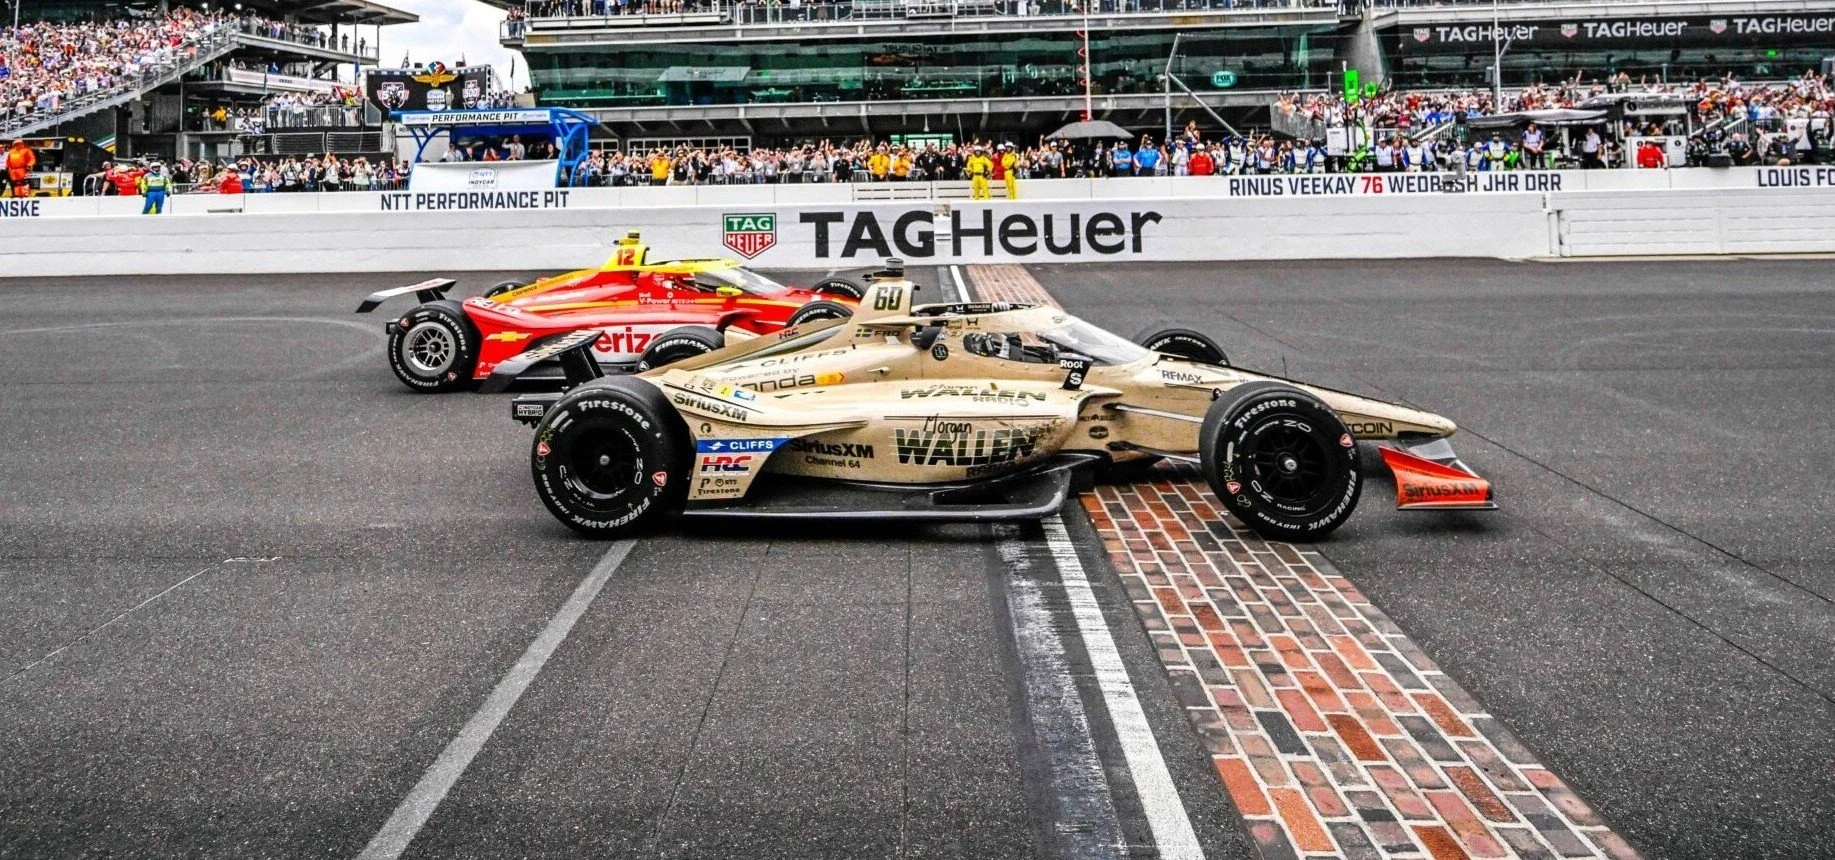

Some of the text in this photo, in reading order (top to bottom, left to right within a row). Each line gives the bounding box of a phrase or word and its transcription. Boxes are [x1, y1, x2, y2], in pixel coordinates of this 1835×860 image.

[432, 113, 501, 122] PERFORMANCE
[504, 112, 520, 120] PIT
[1230, 177, 1283, 196] RINUS
[1288, 176, 1356, 195] VEEKAY
[1361, 175, 1383, 194] 76
[1483, 174, 1519, 192] JHR
[1525, 173, 1561, 191] DRR
[1758, 168, 1811, 187] LOUIS
[381, 191, 570, 210] NTT PERFORMANCE PIT
[728, 217, 771, 231] TAG
[727, 234, 773, 255] HEUER
[617, 248, 635, 266] 12
[873, 286, 903, 311] 60
[594, 326, 664, 355] eriz
[760, 349, 847, 367] CLIFFS
[1060, 359, 1084, 369] Root
[1161, 369, 1202, 384] REMAX
[901, 388, 1047, 401] WALLEN
[972, 396, 1030, 407] RADIO
[578, 399, 650, 431] Firestone
[673, 392, 748, 422] SiriusXM
[1234, 399, 1296, 429] Firestone
[923, 413, 973, 444] Morgan
[729, 440, 774, 450] CLIFFS
[791, 438, 875, 459] SiriusXM
[894, 427, 1039, 467] WALLEN
[701, 455, 752, 472] HRC
[805, 455, 861, 469] Channel 64
[1403, 482, 1481, 498] SiriusXM
[1276, 503, 1307, 511] RACING
[1307, 469, 1358, 532] FIREHAWK
[571, 496, 651, 529] FIREHAWK
